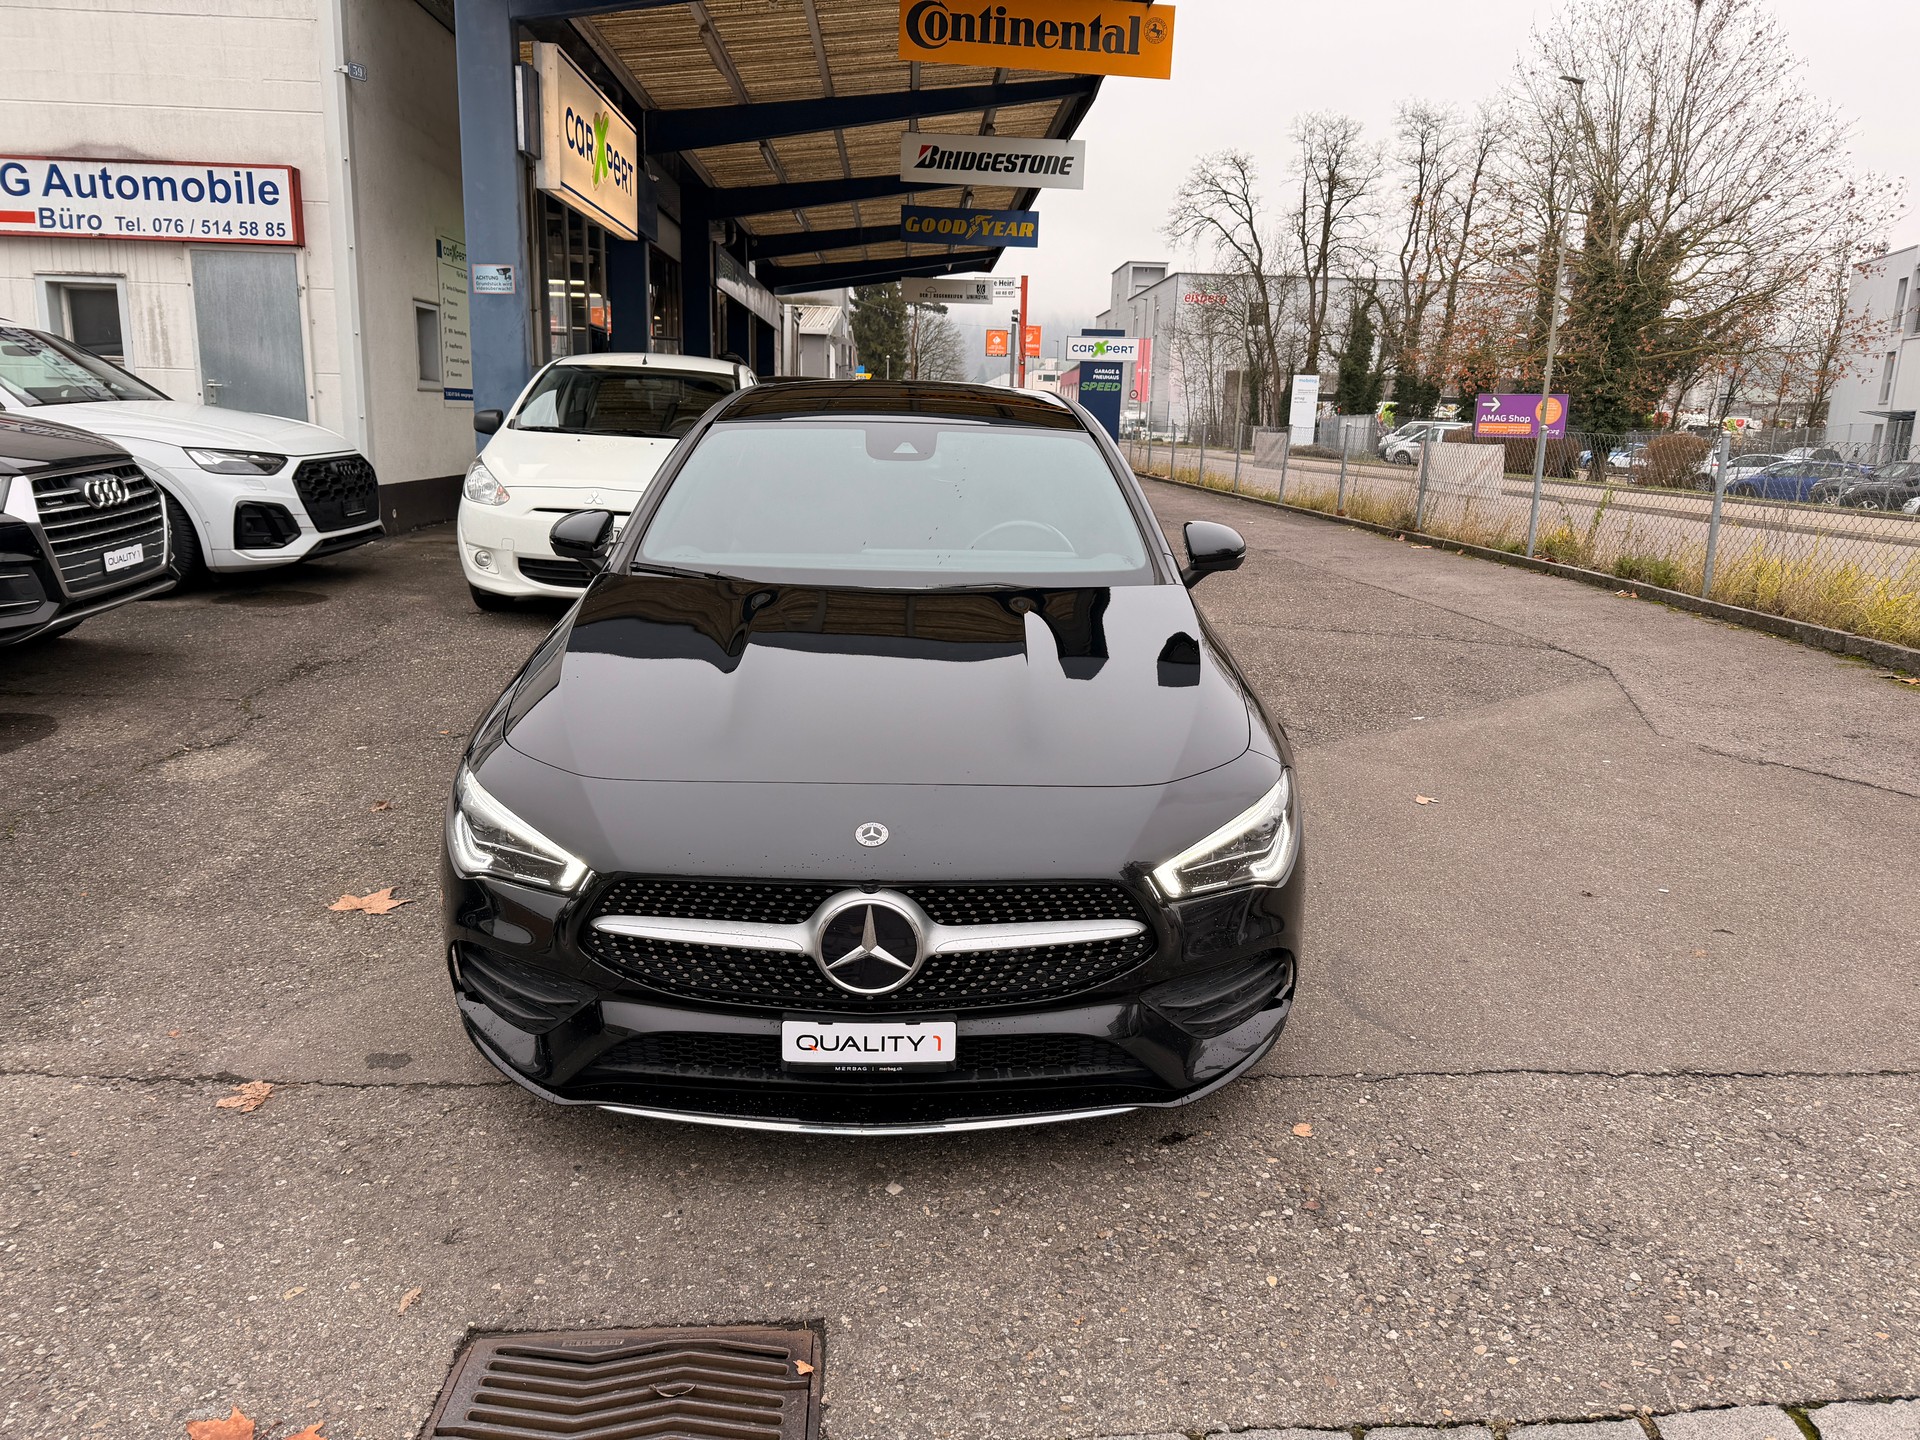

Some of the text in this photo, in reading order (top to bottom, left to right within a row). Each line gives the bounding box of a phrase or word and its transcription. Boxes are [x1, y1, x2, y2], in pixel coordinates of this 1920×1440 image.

[906, 0, 1140, 55] Continental
[914, 144, 1075, 176] BRIDGESTONE
[42, 163, 280, 206] Automobile
[38, 207, 103, 231] Büro
[114, 216, 146, 232] Tel.
[152, 218, 184, 233] 076
[201, 220, 233, 235] 514
[239, 221, 259, 236] 58
[265, 222, 287, 238] 85
[1080, 381, 1121, 391] SPEED
[1480, 414, 1531, 423] AMAG Shop
[108, 551, 136, 566] QUALITY
[796, 1034, 942, 1052] QUALITY 1
